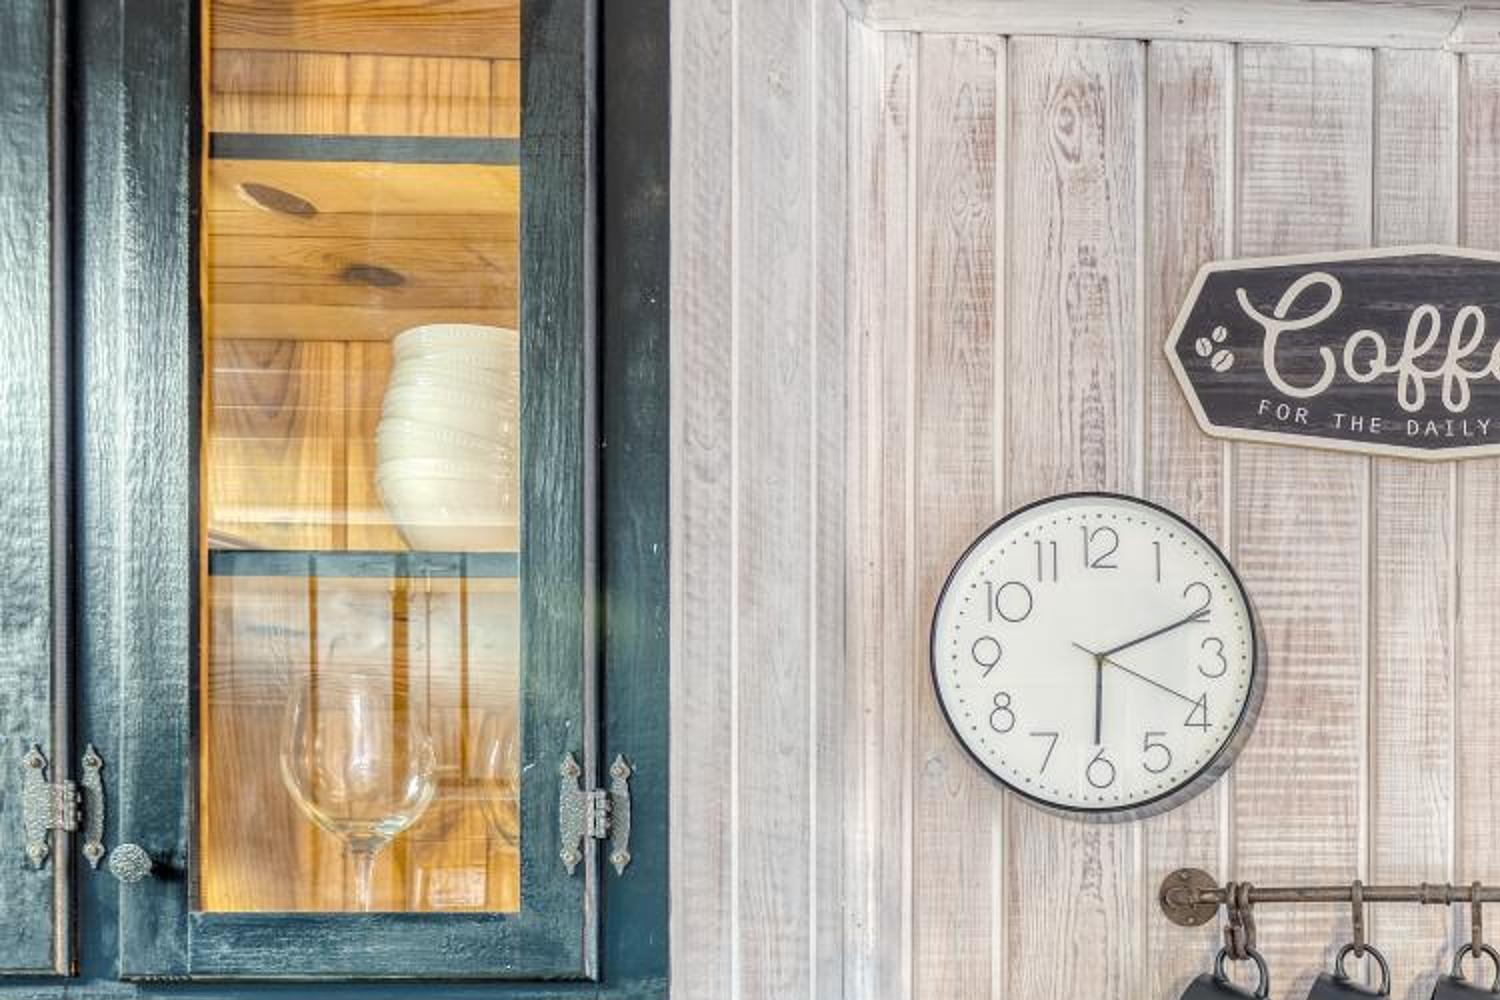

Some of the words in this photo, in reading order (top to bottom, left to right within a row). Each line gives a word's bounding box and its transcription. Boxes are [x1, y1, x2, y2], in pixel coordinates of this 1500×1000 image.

[1257, 398, 1310, 426] FOR
[1333, 412, 1384, 434] THE
[1406, 418, 1493, 438] DAILY
[1034, 540, 1057, 583] 11
[1081, 526, 1120, 569] 12
[1152, 541, 1162, 584] 1
[984, 581, 1033, 623] 10
[1183, 581, 1212, 623] 2
[971, 636, 1002, 678] 9
[1198, 637, 1227, 678] 3
[989, 692, 1016, 733] 8
[1183, 692, 1213, 733] 4
[1029, 732, 1059, 775] 7
[1086, 747, 1116, 789] 6
[1143, 731, 1172, 774] 5
